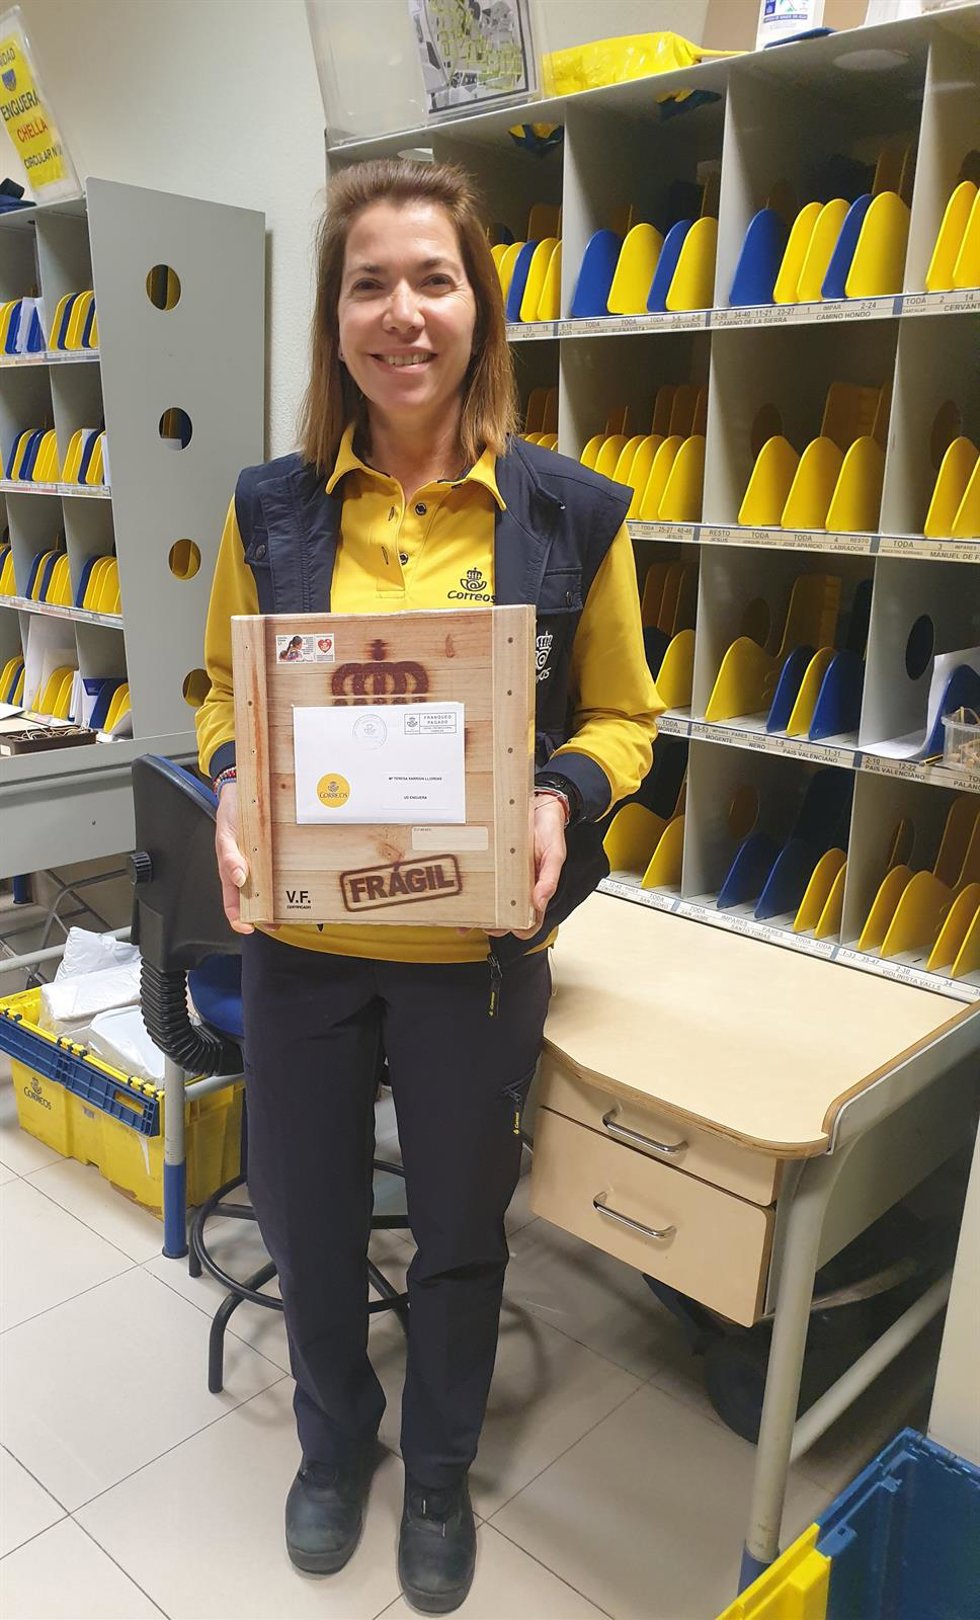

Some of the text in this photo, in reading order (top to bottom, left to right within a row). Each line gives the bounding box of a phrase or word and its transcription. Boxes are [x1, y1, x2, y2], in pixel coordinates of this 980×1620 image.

[1, 89, 41, 122] ENGUERA
[17, 117, 48, 143] CHELLA
[24, 148, 54, 170] CIRCULAR
[906, 296, 927, 305] TODA
[816, 311, 871, 321] CAMINO HONDO
[719, 319, 743, 327] CAMINO
[709, 529, 731, 538] RESTO
[752, 531, 770, 540] TODA
[794, 534, 813, 542] TODA
[893, 540, 914, 549] TODA
[930, 551, 961, 560] MANUEL
[447, 590, 496, 604] Correos
[662, 719, 679, 728] TODA
[798, 751, 839, 764] VALENCIANO
[864, 764, 926, 781] PAIS VALENCIANO
[898, 762, 917, 772] 12-22
[319, 792, 349, 800] CORREOS
[349, 862, 455, 903] FRÁGIL
[286, 890, 312, 904] V.F.
[721, 914, 748, 928] IMPARES
[882, 968, 919, 985] VIOLINISTA
